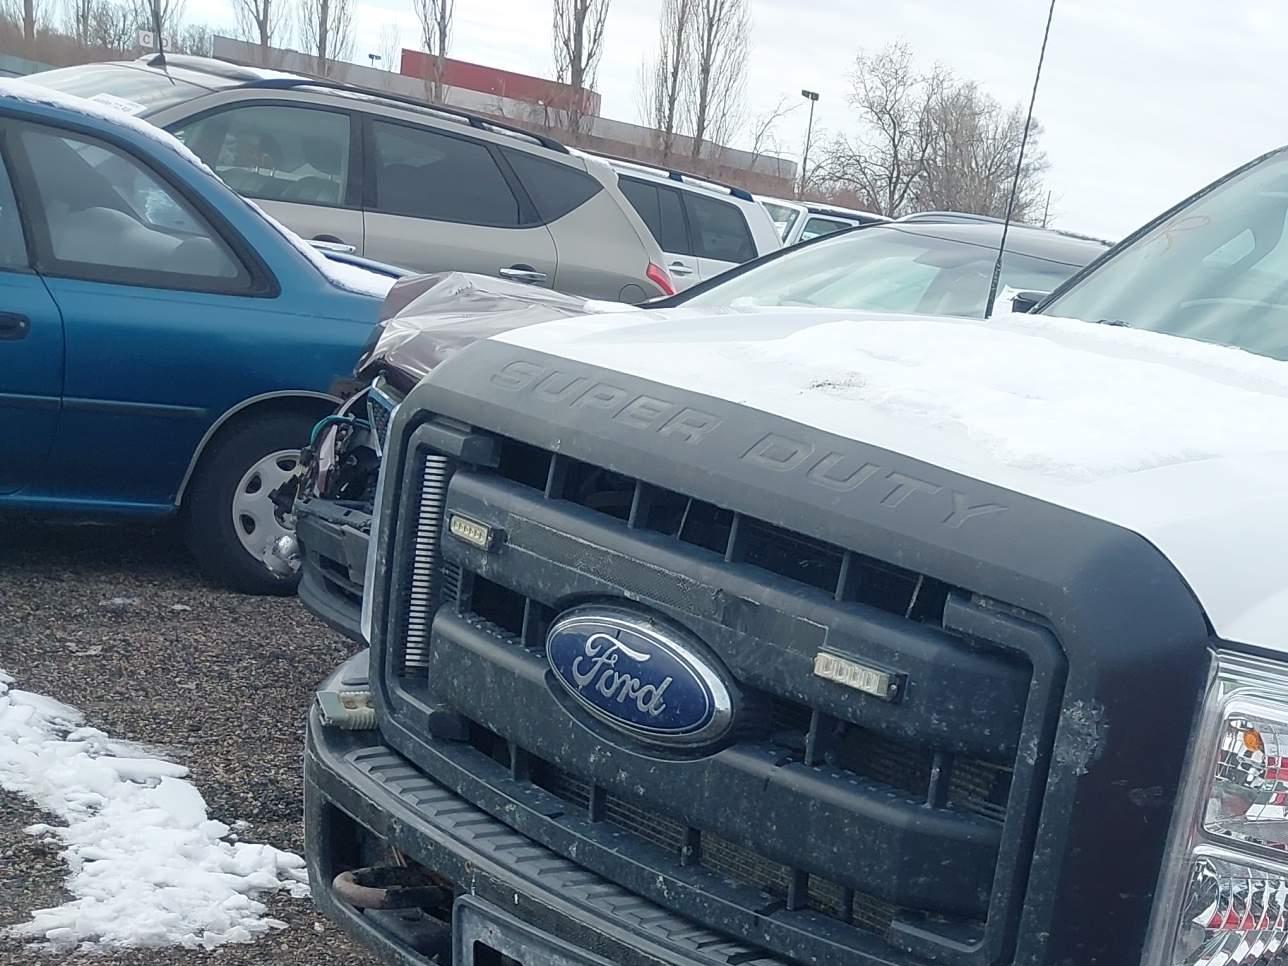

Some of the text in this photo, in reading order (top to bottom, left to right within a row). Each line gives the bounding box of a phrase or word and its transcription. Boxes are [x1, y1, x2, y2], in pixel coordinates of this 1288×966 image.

[490, 361, 1008, 528] SUPER DUTY
[572, 633, 673, 717] Ford
